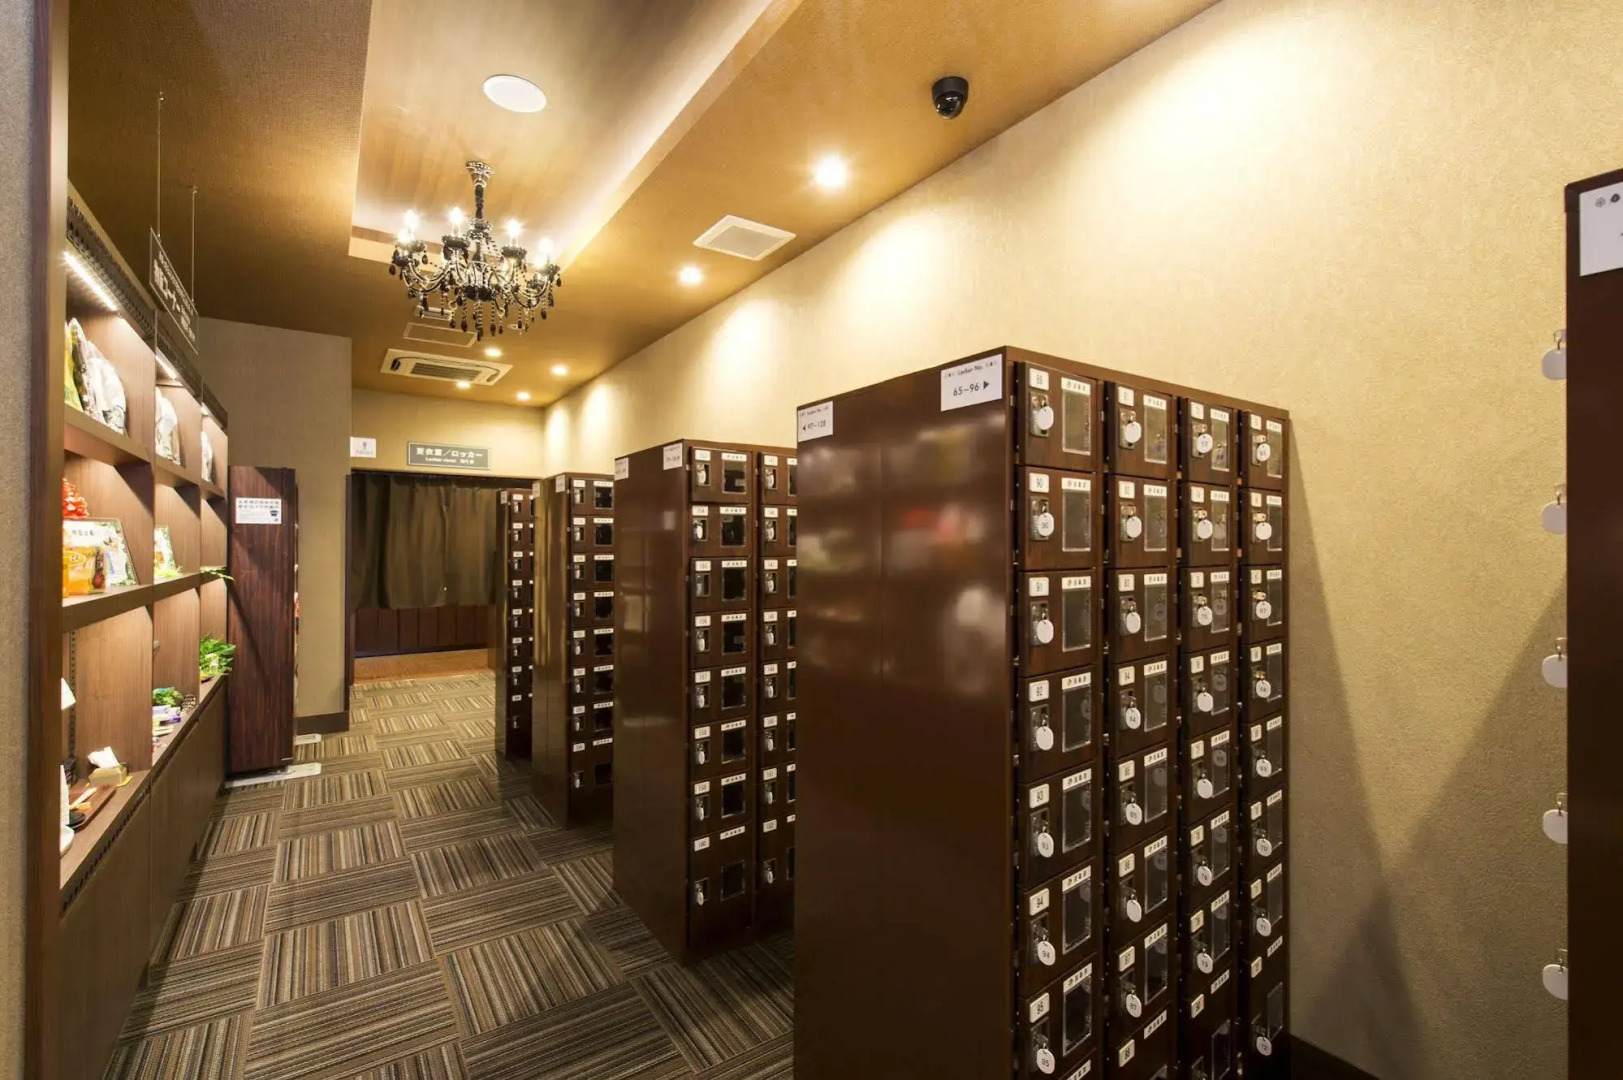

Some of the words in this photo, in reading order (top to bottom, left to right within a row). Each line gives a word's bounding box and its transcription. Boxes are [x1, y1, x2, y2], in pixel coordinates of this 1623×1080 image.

[1036, 790, 1044, 802] 93
[1036, 896, 1044, 909] 94
[1036, 1001, 1044, 1015] 95
